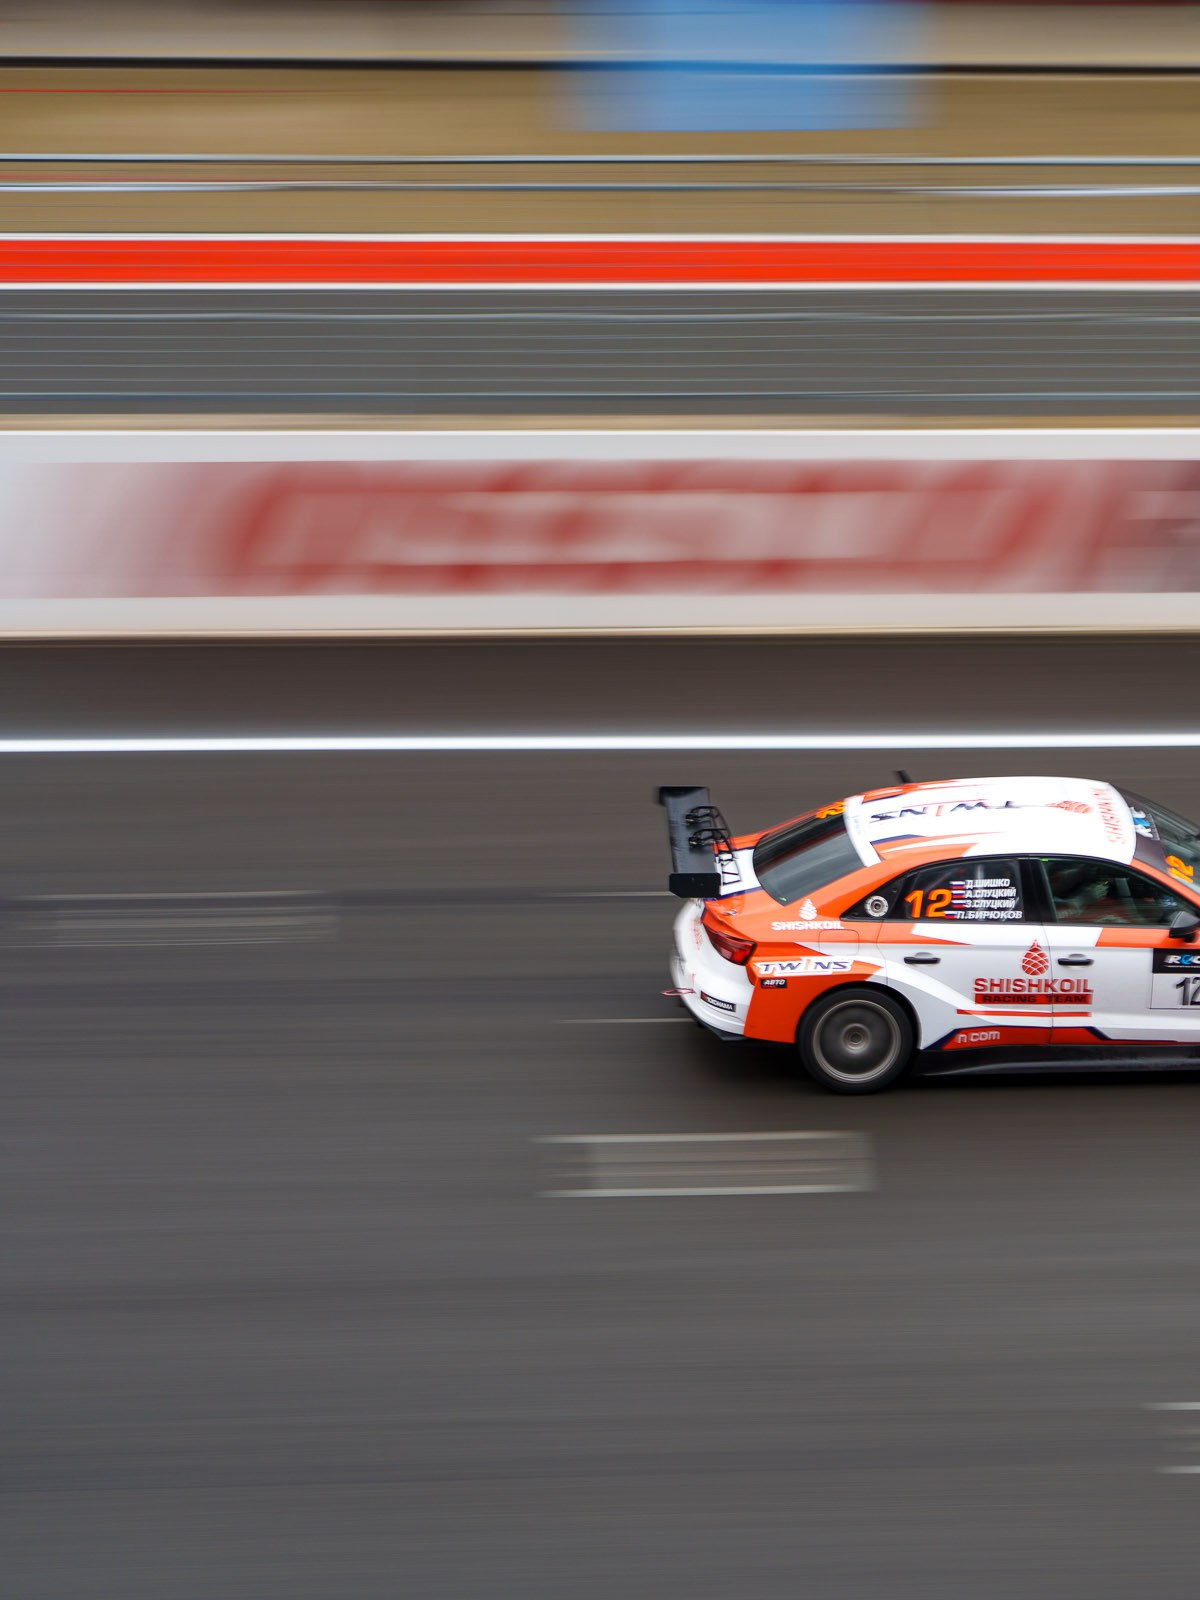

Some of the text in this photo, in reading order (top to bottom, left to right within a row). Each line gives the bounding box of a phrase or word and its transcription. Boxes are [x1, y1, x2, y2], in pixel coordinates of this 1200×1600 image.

[1164, 855, 1194, 883] 12
[965, 879, 1010, 889] Д.ШИШКО
[965, 887, 1016, 899] А.СЛУЦКИЙ
[904, 888, 953, 919] 12
[956, 911, 1023, 919] П.БИРЮКОВ
[771, 921, 845, 930] SHISHKOIL
[760, 959, 849, 972] TWINS
[973, 978, 1094, 993] SHISHKOIL
[983, 995, 1087, 1003] RACING TEAM
